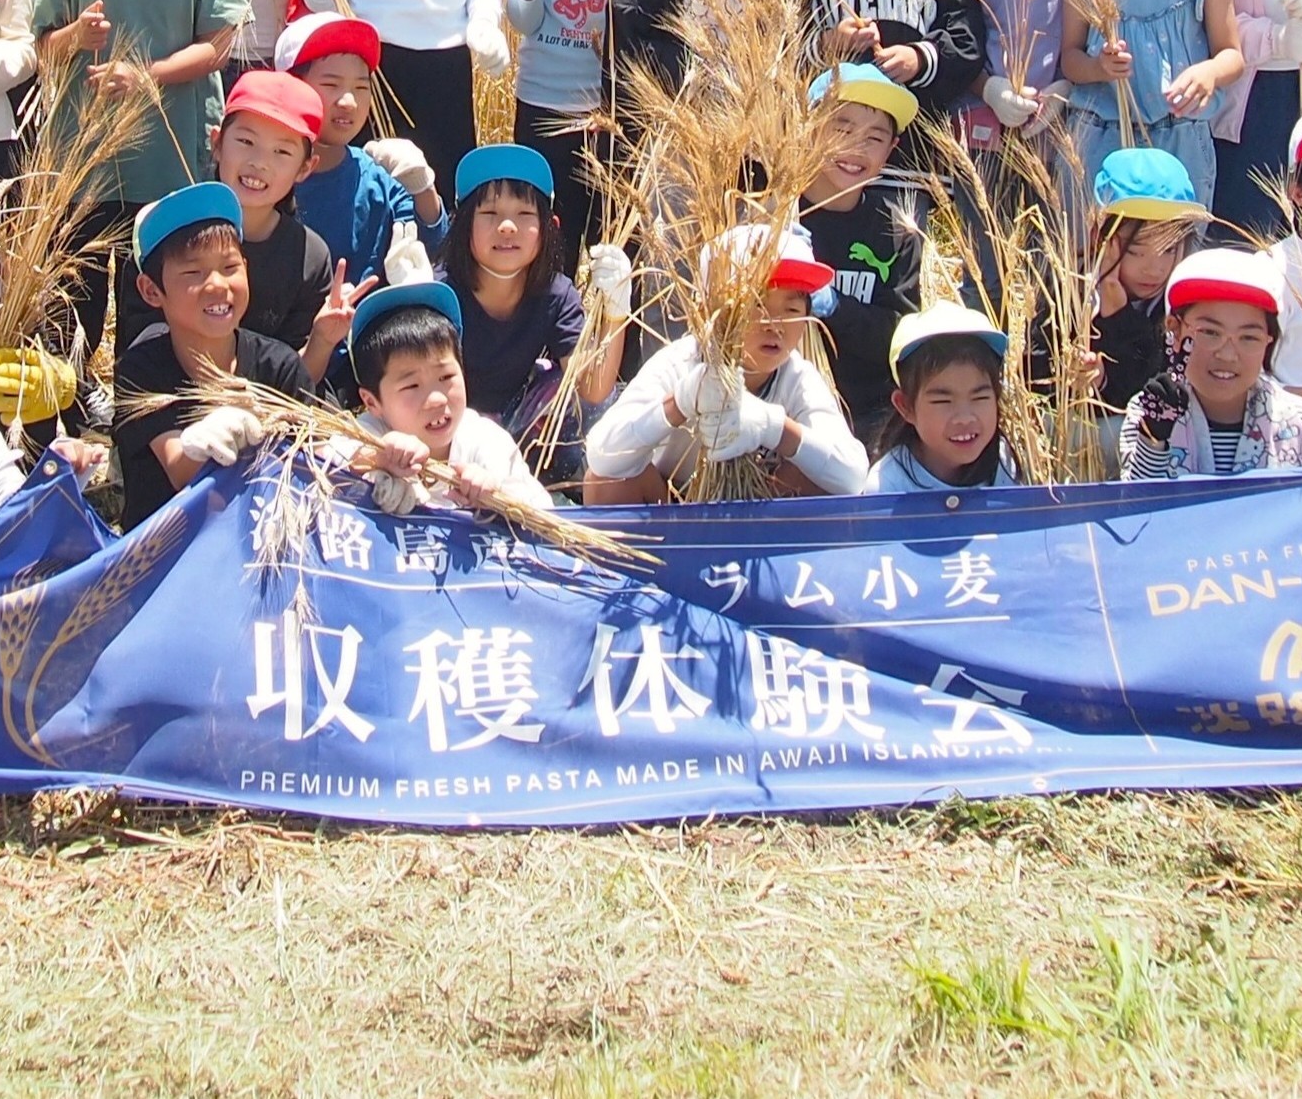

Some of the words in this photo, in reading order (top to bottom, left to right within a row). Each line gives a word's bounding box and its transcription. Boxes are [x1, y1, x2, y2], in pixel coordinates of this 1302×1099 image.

[1186, 548, 1269, 573] PASTA
[246, 609, 1034, 752] 収穫体験会
[240, 770, 381, 799] PREMIUM
[395, 769, 492, 799] FRESH
[506, 769, 602, 794] PASTA
[616, 759, 701, 787] MADE
[714, 754, 746, 776] IN
[758, 746, 848, 772] AWAJI
